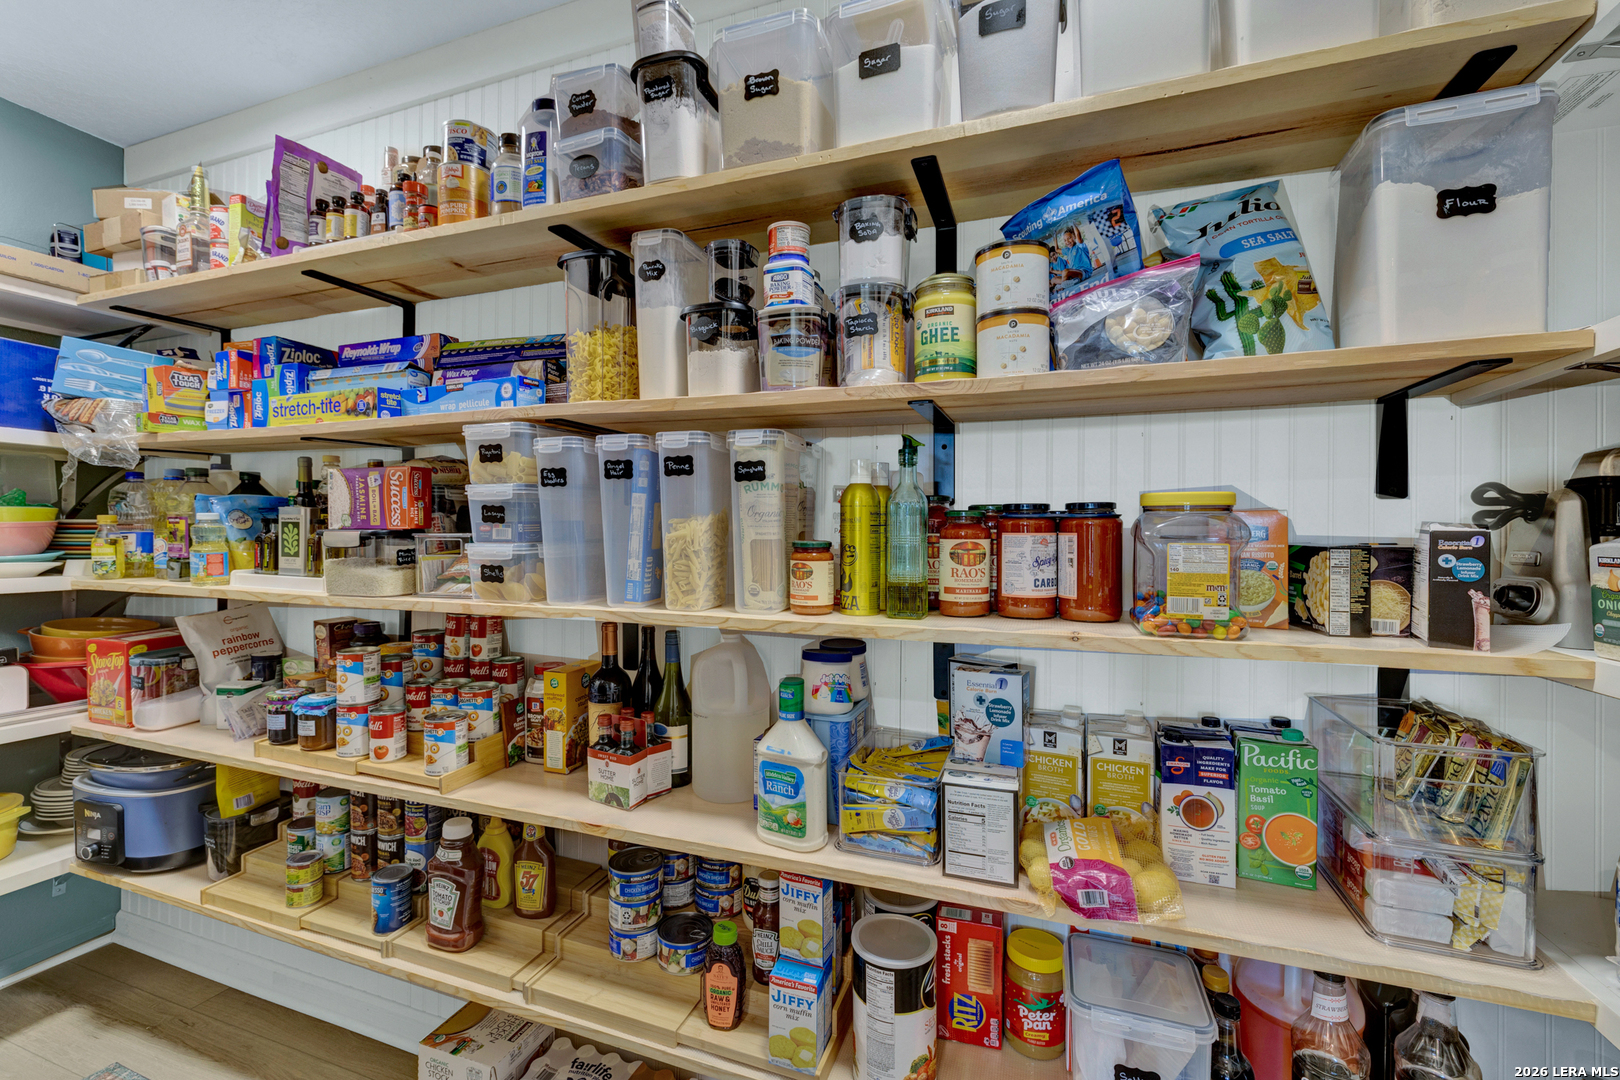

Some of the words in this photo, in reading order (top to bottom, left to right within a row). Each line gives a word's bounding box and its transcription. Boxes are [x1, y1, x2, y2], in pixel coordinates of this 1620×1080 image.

[985, 4, 1016, 20] Sugar
[864, 54, 892, 68] Sugar
[749, 75, 774, 84] Brown
[650, 88, 670, 98] Sugar
[750, 83, 774, 94] Sugar
[1012, 218, 1043, 240] Scouting
[1058, 192, 1108, 217] America
[1236, 216, 1274, 228] TORTILLA
[1241, 236, 1266, 249] SEA
[1266, 230, 1294, 242] SALT
[926, 306, 954, 314] KIRKLAND
[920, 326, 960, 346] GHEE
[266, 343, 276, 370] Ziploc
[281, 347, 321, 364] Ziploc
[342, 345, 378, 358] Reynolds
[380, 342, 402, 356] Wrap
[174, 373, 200, 382] TEXAS
[446, 370, 460, 378] Wax
[460, 368, 480, 378] Paper
[173, 380, 200, 389] TOUGH
[254, 392, 262, 420] Ziploc
[272, 398, 342, 418] stretch-tite
[440, 401, 456, 412] wrap
[458, 398, 490, 412] pellicule
[668, 462, 690, 471] Penne
[390, 469, 404, 527] Success
[950, 568, 986, 578] RAO'S
[222, 631, 260, 646] rainbow
[212, 637, 275, 659] peppercorns
[966, 680, 997, 689] Essential
[1029, 754, 1072, 768] CHICKEN
[1240, 743, 1318, 770] Pacific
[598, 768, 616, 777] SUTTER
[1038, 764, 1064, 774] BROTH
[1096, 762, 1144, 776] CHICKEN
[766, 771, 780, 780] Hidden
[780, 774, 795, 783] Valley
[1106, 772, 1135, 781] BROTH
[766, 781, 794, 796] Ranch
[1249, 784, 1287, 796] Tomato
[1250, 795, 1274, 804] Basil
[84, 808, 101, 820] NINJA
[1074, 822, 1092, 852] GOLD
[520, 871, 539, 890] 57
[780, 872, 801, 882] America's
[802, 877, 821, 886] Favorite
[435, 882, 450, 891] HEINZ
[781, 883, 820, 904] JIFFY
[432, 890, 453, 901] TOMATO
[782, 897, 796, 905] corn
[797, 900, 818, 910] muffin
[756, 946, 774, 954] SAUCE
[943, 934, 952, 961] stacks
[942, 962, 952, 985] fresh
[771, 977, 795, 987] America's
[795, 982, 816, 992] Favorite
[710, 994, 724, 1002] RAW
[771, 990, 815, 1010] JIFFY
[711, 1004, 730, 1012] HONEY
[773, 1004, 788, 1012] corn
[789, 1007, 812, 1018] muffin
[952, 992, 977, 1032] RITZ
[1018, 1006, 1056, 1022] Peter
[1022, 1018, 1052, 1031] Pan
[1024, 1032, 1048, 1040] Creamy
[430, 1057, 449, 1066] ORGANIC
[425, 1061, 454, 1077] CHICKEN
